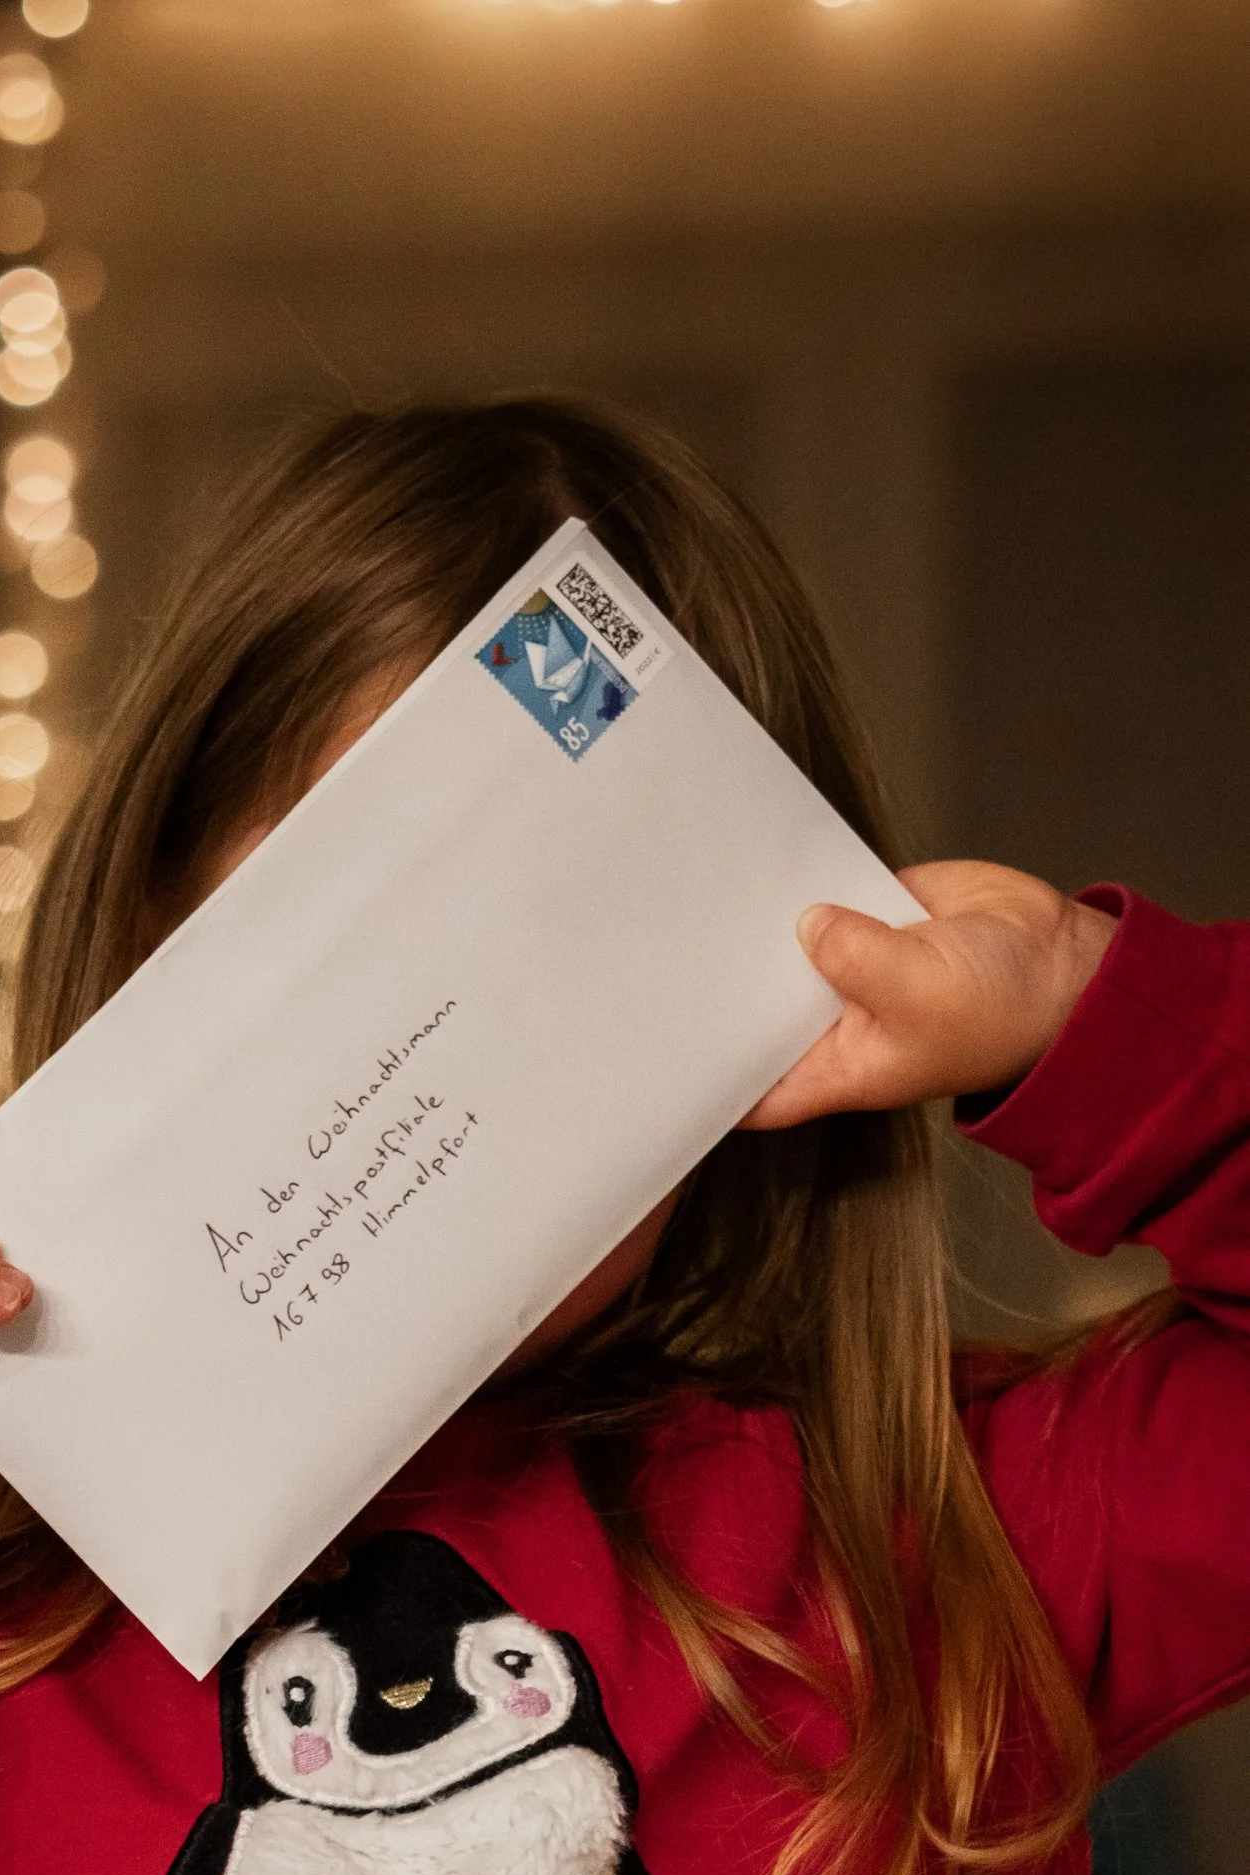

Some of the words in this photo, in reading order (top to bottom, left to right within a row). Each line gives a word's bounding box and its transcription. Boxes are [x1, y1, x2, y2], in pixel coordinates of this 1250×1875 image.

[559, 716, 589, 750] 85
[205, 1222, 254, 1274] An
[258, 1181, 300, 1214] den
[307, 1000, 457, 1161] Weihnachtsmann
[361, 1111, 479, 1238] Himmelpfort
